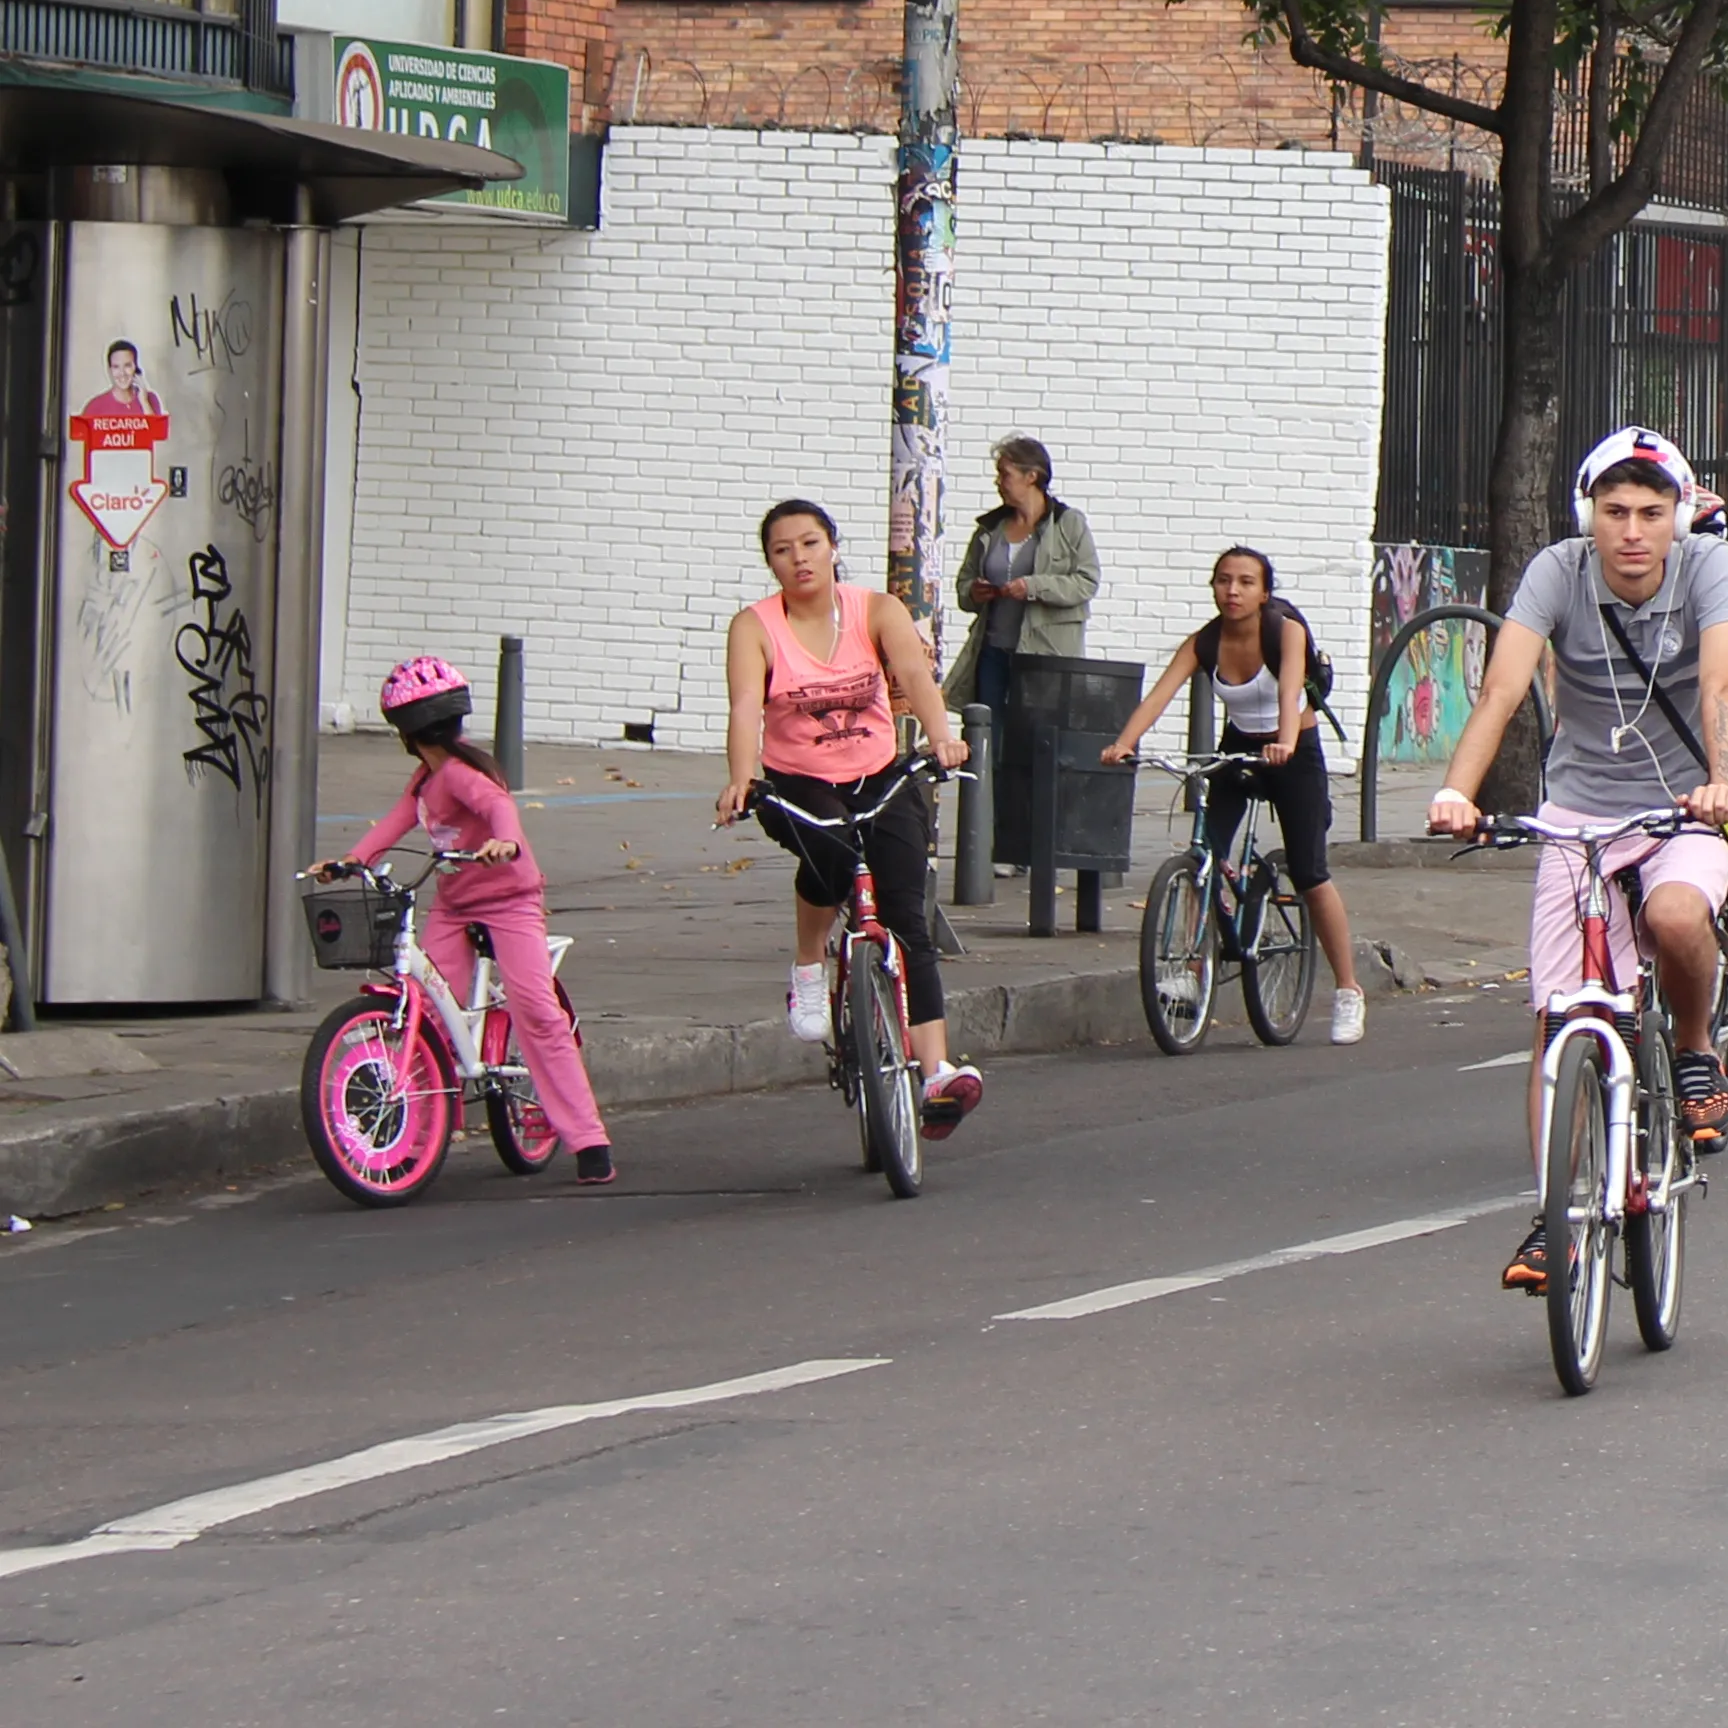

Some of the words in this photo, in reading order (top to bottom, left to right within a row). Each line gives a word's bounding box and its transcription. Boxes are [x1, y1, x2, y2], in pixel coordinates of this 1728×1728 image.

[388, 54, 444, 79] UNIVERSIDAD
[444, 63, 457, 80] DE
[458, 63, 496, 85] CIENCIAS
[388, 79, 433, 103] APLICADAS
[434, 89, 441, 103] Y
[441, 88, 496, 110] AMBIENTALES
[466, 183, 560, 212] www.udca.edu.co
[94, 418, 149, 431] RECARGA
[103, 430, 135, 447] AQUÍ
[90, 491, 146, 511] Claro
